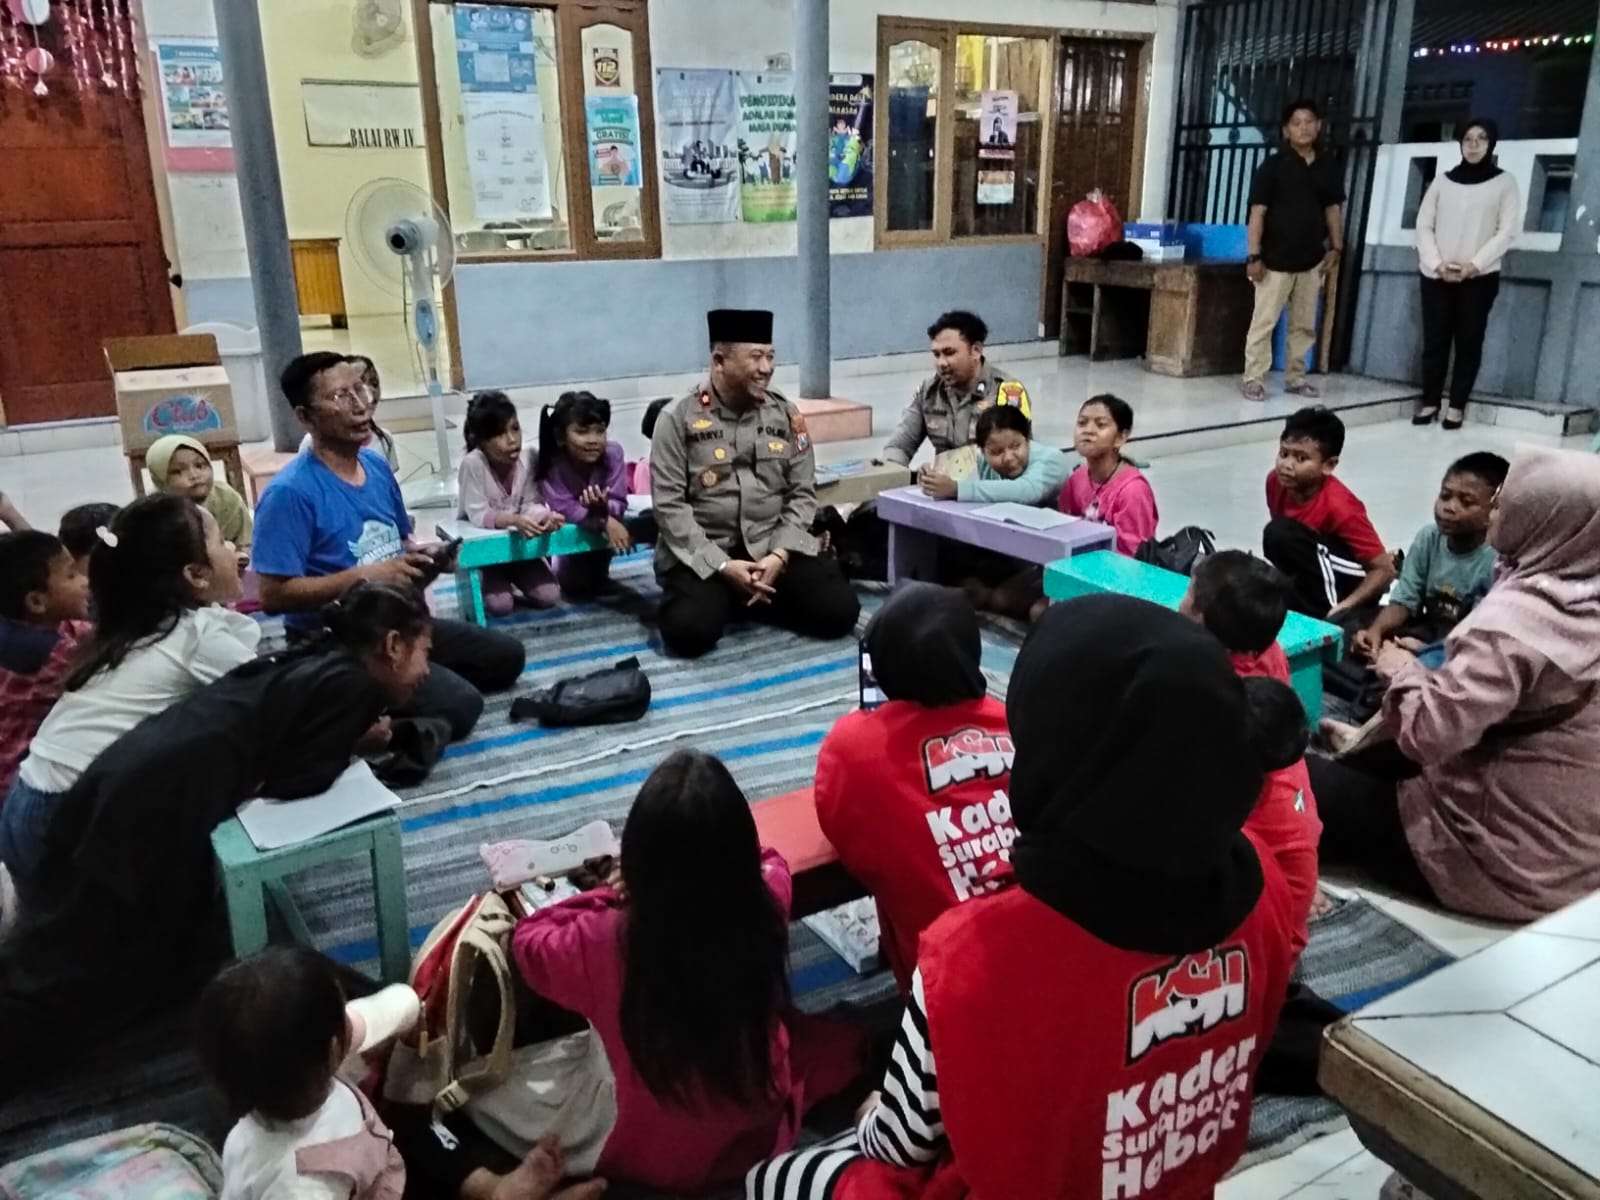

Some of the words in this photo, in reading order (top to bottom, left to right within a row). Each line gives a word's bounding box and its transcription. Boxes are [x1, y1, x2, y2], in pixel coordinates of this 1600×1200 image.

[596, 61, 618, 73] 112
[739, 95, 796, 108] PENDIDIKA
[349, 128, 382, 148] BALAI
[383, 128, 400, 148] RW
[403, 128, 415, 148] IV
[925, 789, 1013, 846] Kad
[939, 825, 1021, 869] Surab
[1105, 1033, 1256, 1133] Kader
[1102, 1072, 1249, 1161] Surabaya
[1102, 1100, 1240, 1200] Hebat
